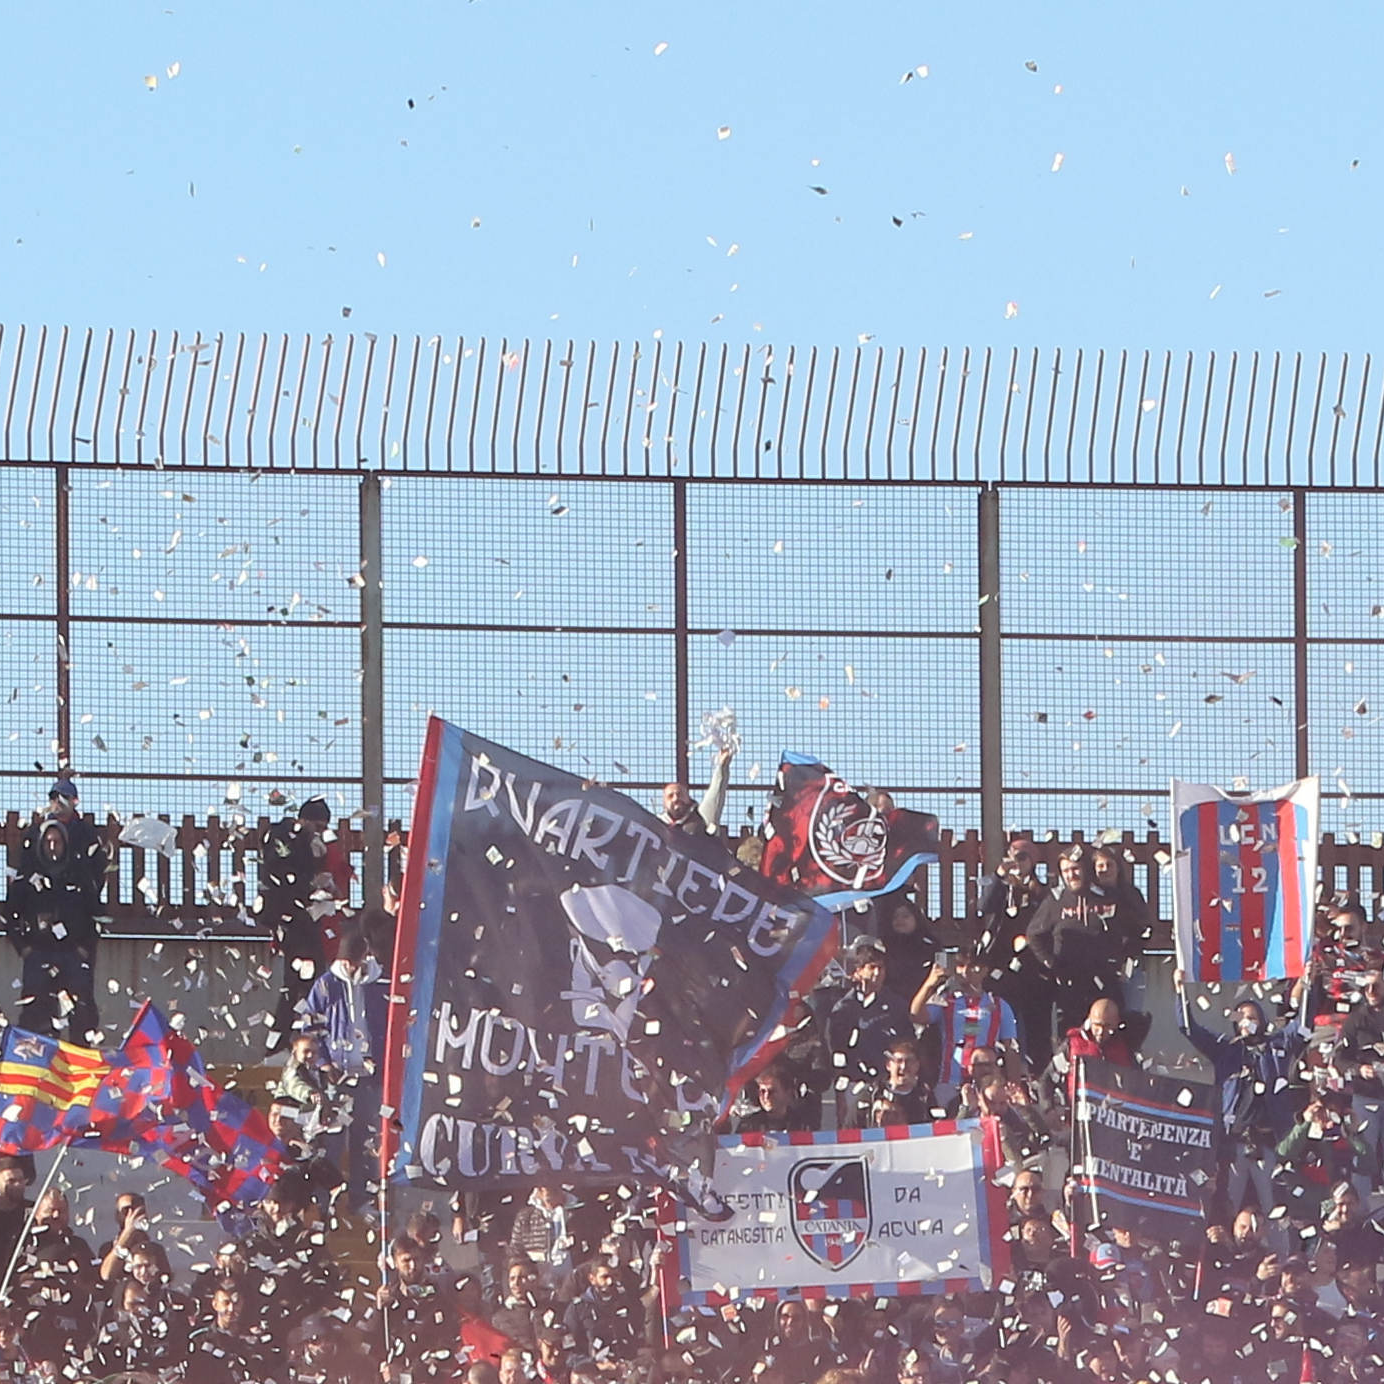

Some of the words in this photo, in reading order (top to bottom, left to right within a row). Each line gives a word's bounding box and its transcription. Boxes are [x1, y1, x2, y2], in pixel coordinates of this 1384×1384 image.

[1231, 866, 1268, 893] 12
[1080, 1102, 1211, 1148] PPARTENENZA
[1129, 1142, 1142, 1161] E
[894, 1186, 921, 1203] DA
[804, 1220, 862, 1233] CATANIA
